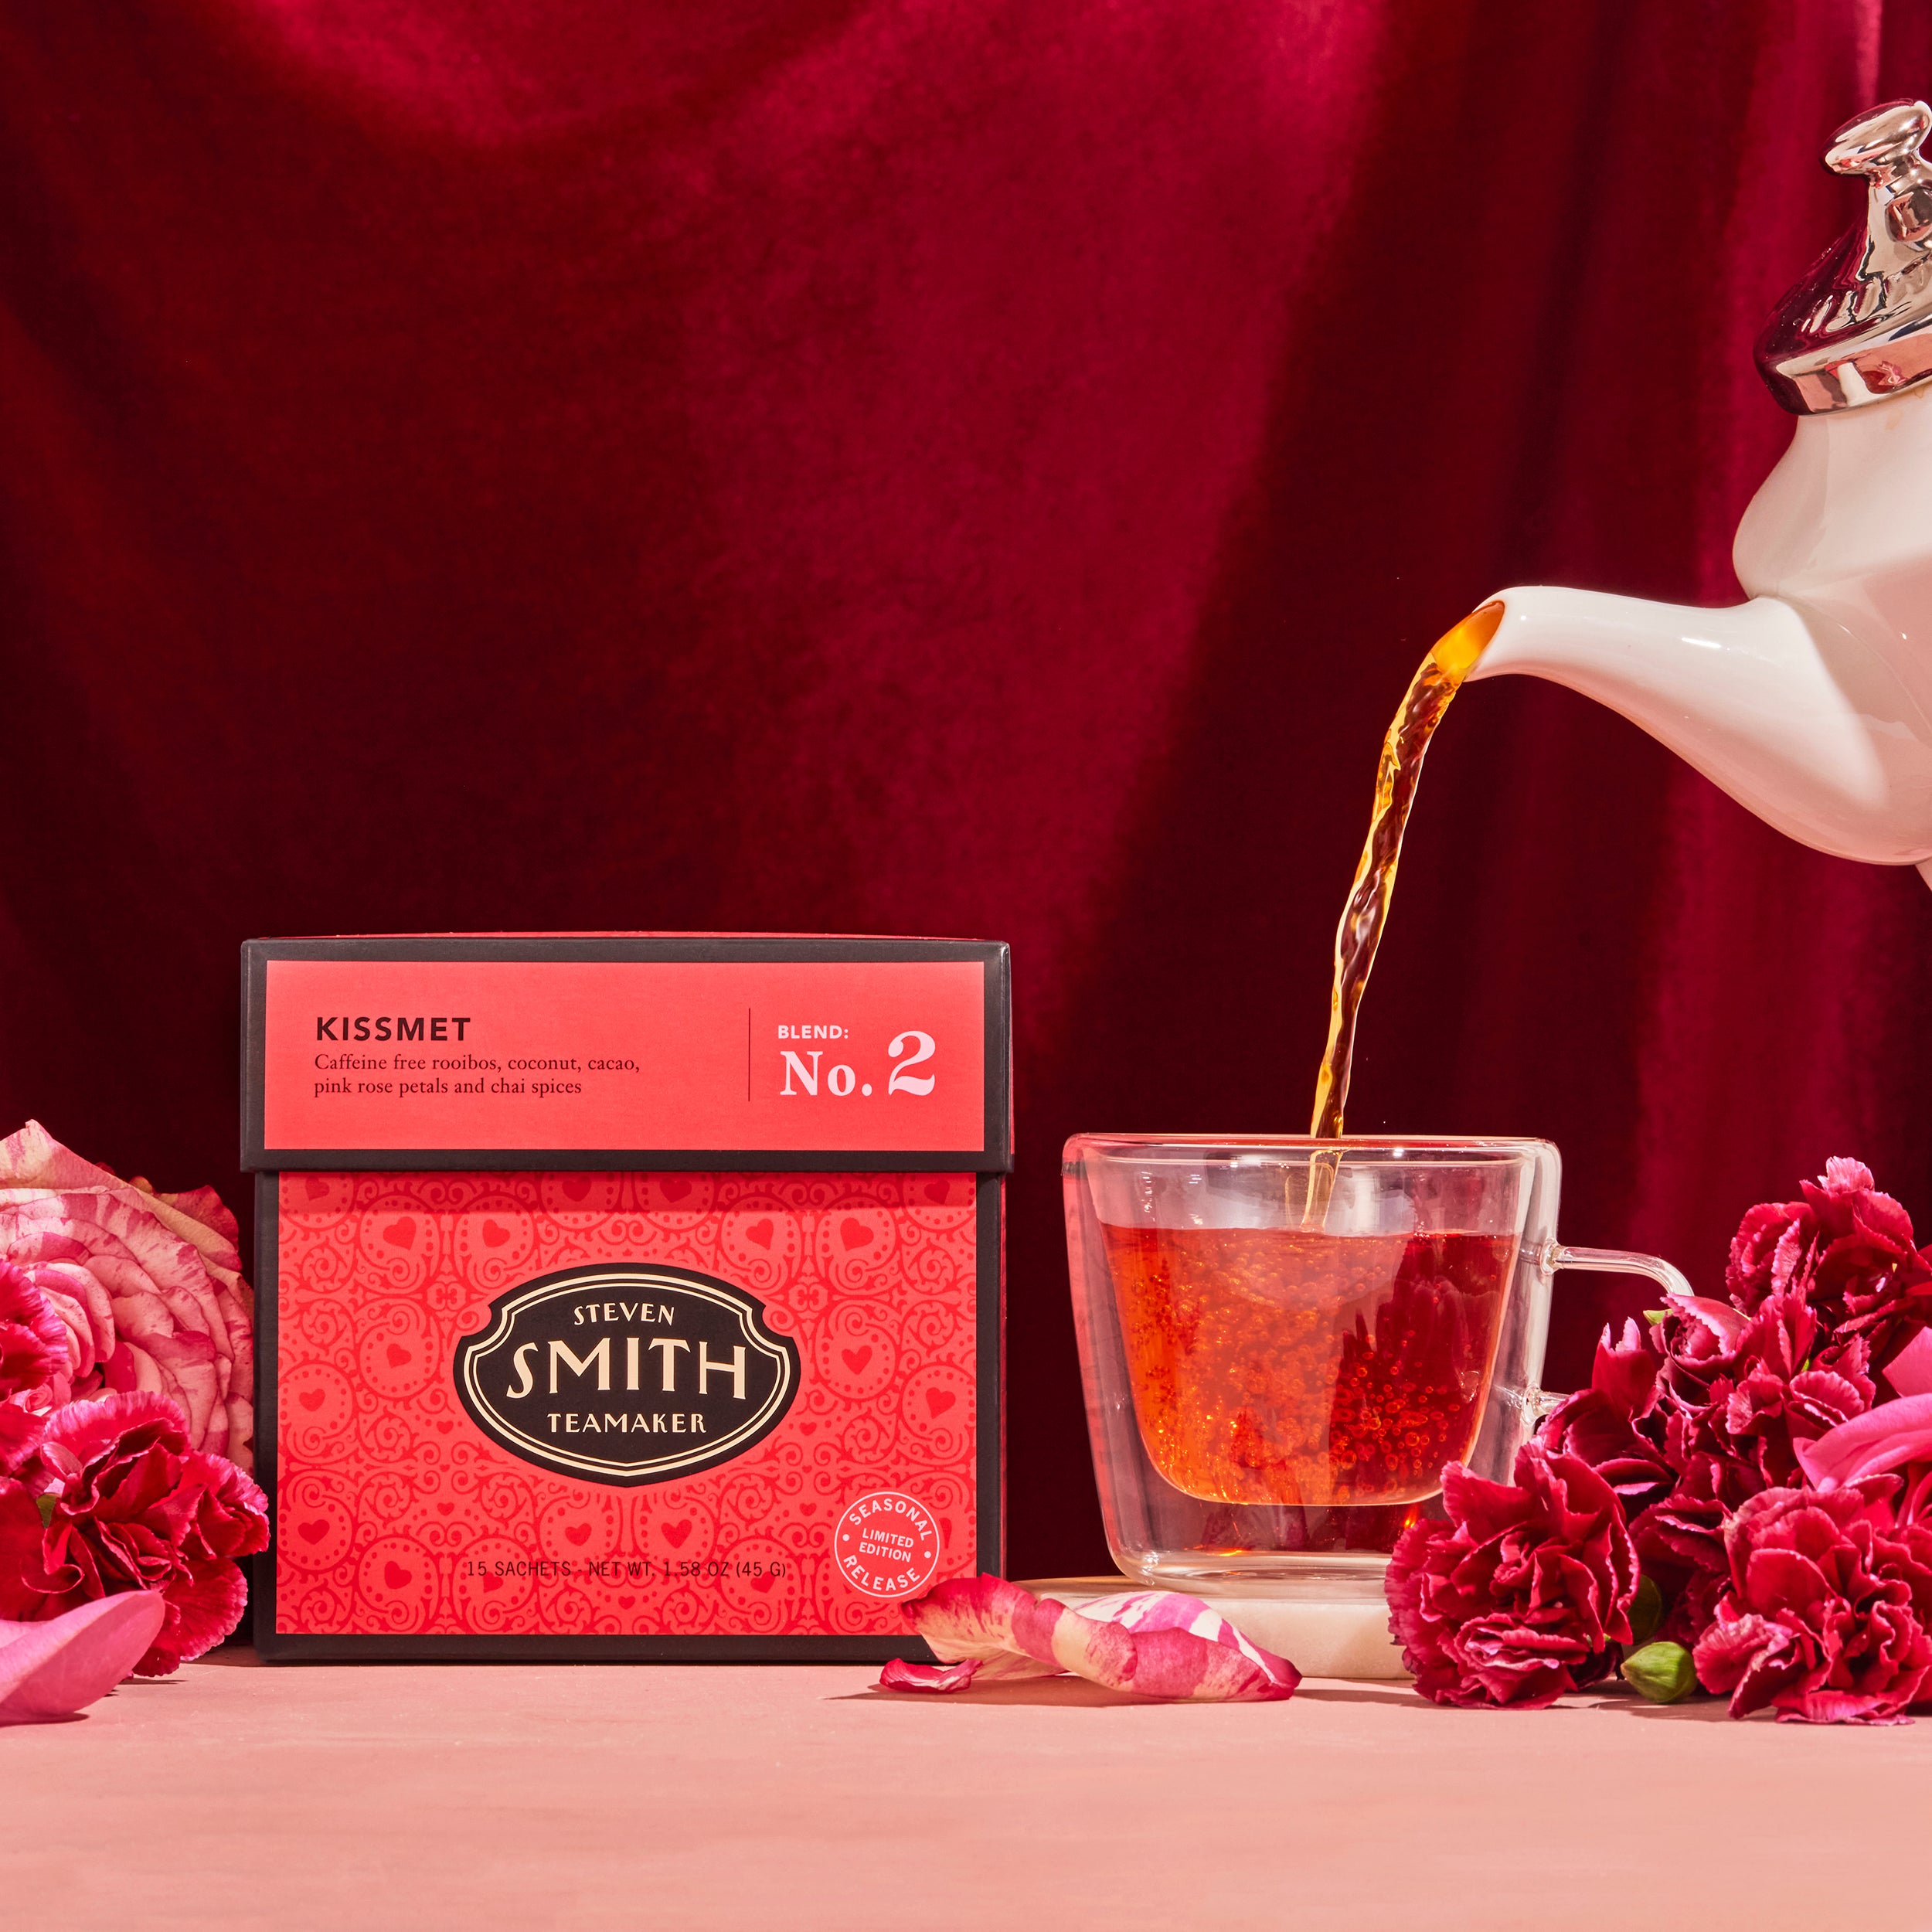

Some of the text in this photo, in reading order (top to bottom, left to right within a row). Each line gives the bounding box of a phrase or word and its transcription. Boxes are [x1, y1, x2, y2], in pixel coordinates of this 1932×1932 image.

[317, 1017, 471, 1041] KISSMET
[778, 1026, 848, 1039] BLEND:
[315, 1054, 639, 1072] Caffeine free rooibos, coconut, cacao,
[781, 1031, 935, 1096] No. 2
[315, 1078, 581, 1097] pink rose petals and chai spices
[574, 1303, 674, 1325] STEVEN
[506, 1337, 746, 1400] SMITH
[548, 1414, 706, 1433] TEAMAKER
[849, 1498, 933, 1541] SEASONAL
[862, 1528, 913, 1548] LIMITED
[859, 1542, 912, 1563] EDITION
[469, 1562, 486, 1576] 15
[495, 1561, 570, 1576] SACHETS
[589, 1561, 621, 1577] NET
[628, 1561, 655, 1577] WT.
[665, 1562, 700, 1576] 1.58
[708, 1562, 729, 1576] OZ
[736, 1562, 762, 1577] (45
[770, 1562, 785, 1577] G)
[843, 1555, 920, 1591] RELEASE
